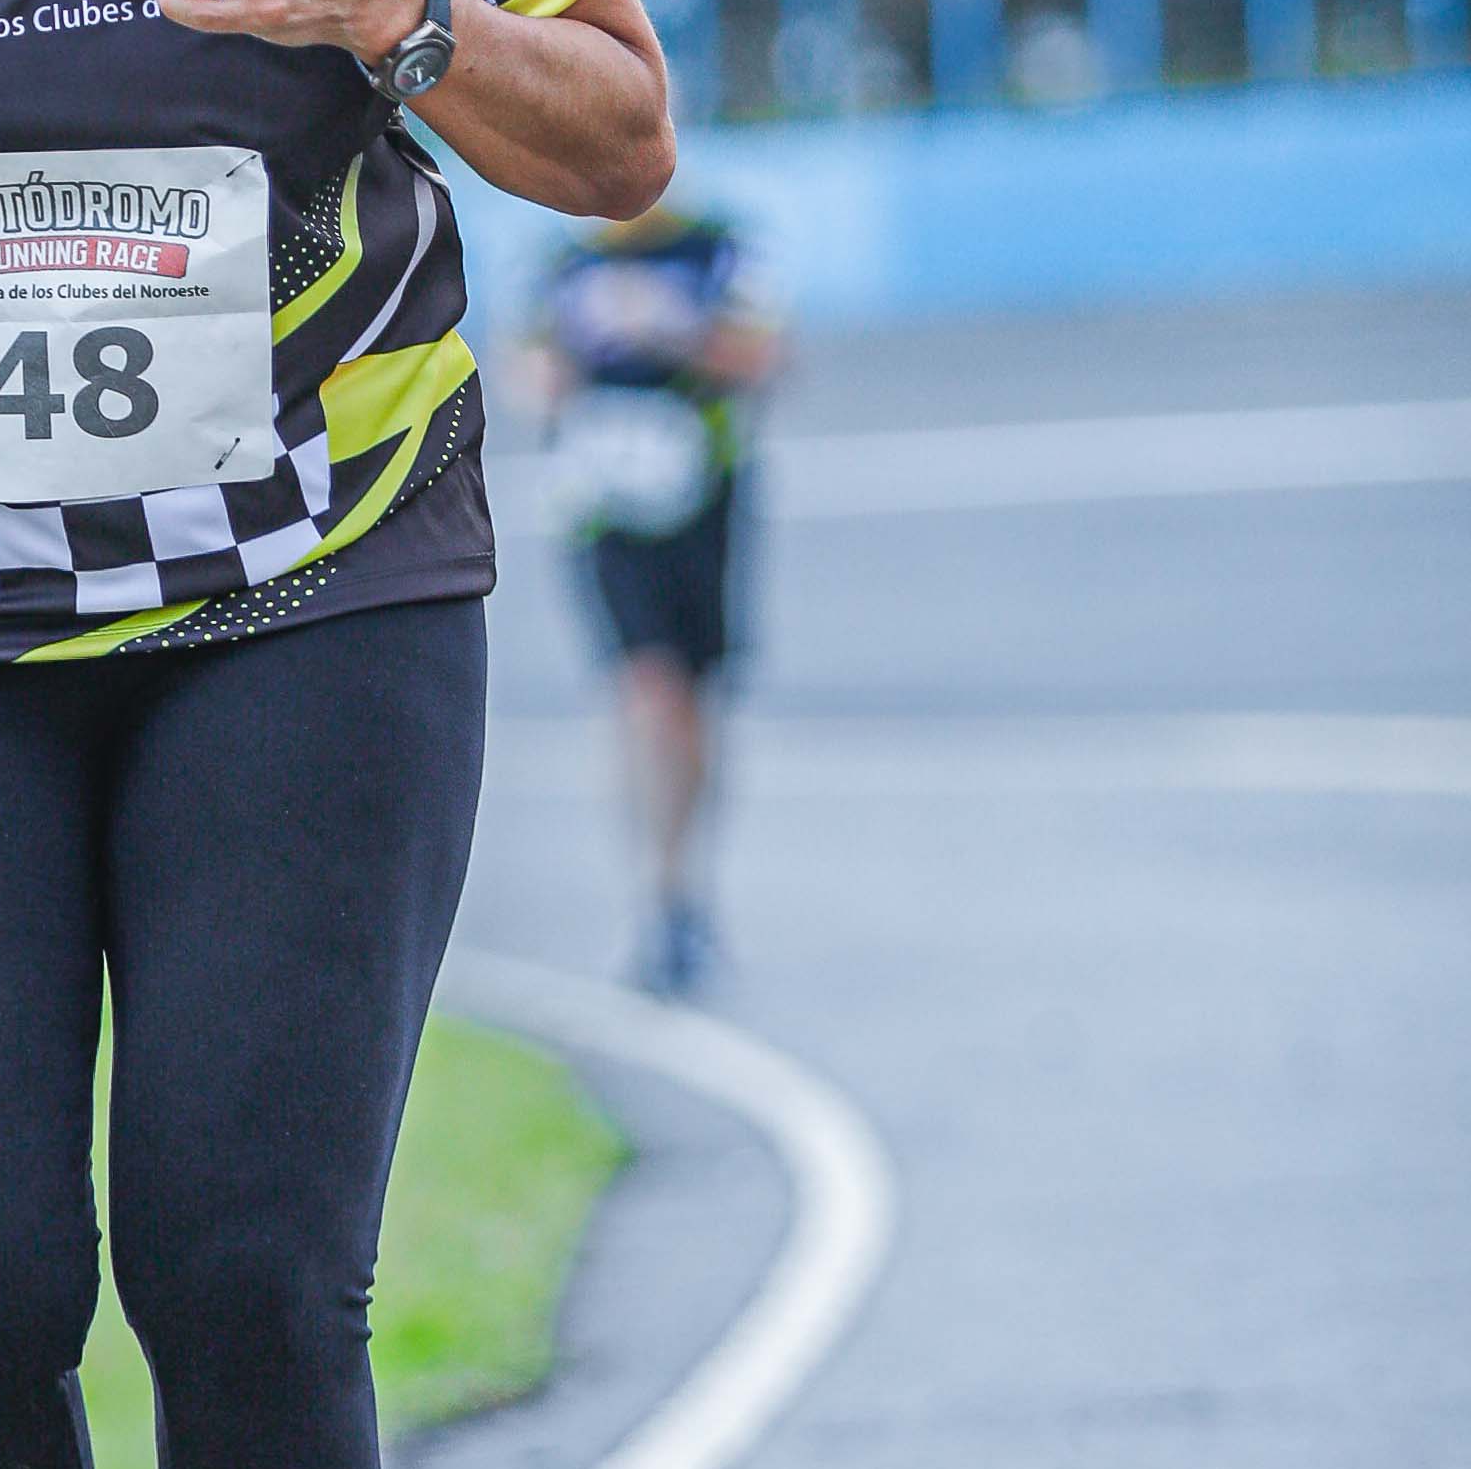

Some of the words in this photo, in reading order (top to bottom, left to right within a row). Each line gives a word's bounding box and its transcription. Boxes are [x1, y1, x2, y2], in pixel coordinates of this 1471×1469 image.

[95, 240, 162, 273] RACE
[8, 284, 28, 300] de
[31, 284, 53, 299] los
[57, 284, 109, 300] Clubes
[112, 283, 137, 300] del
[140, 283, 210, 299] Noroeste
